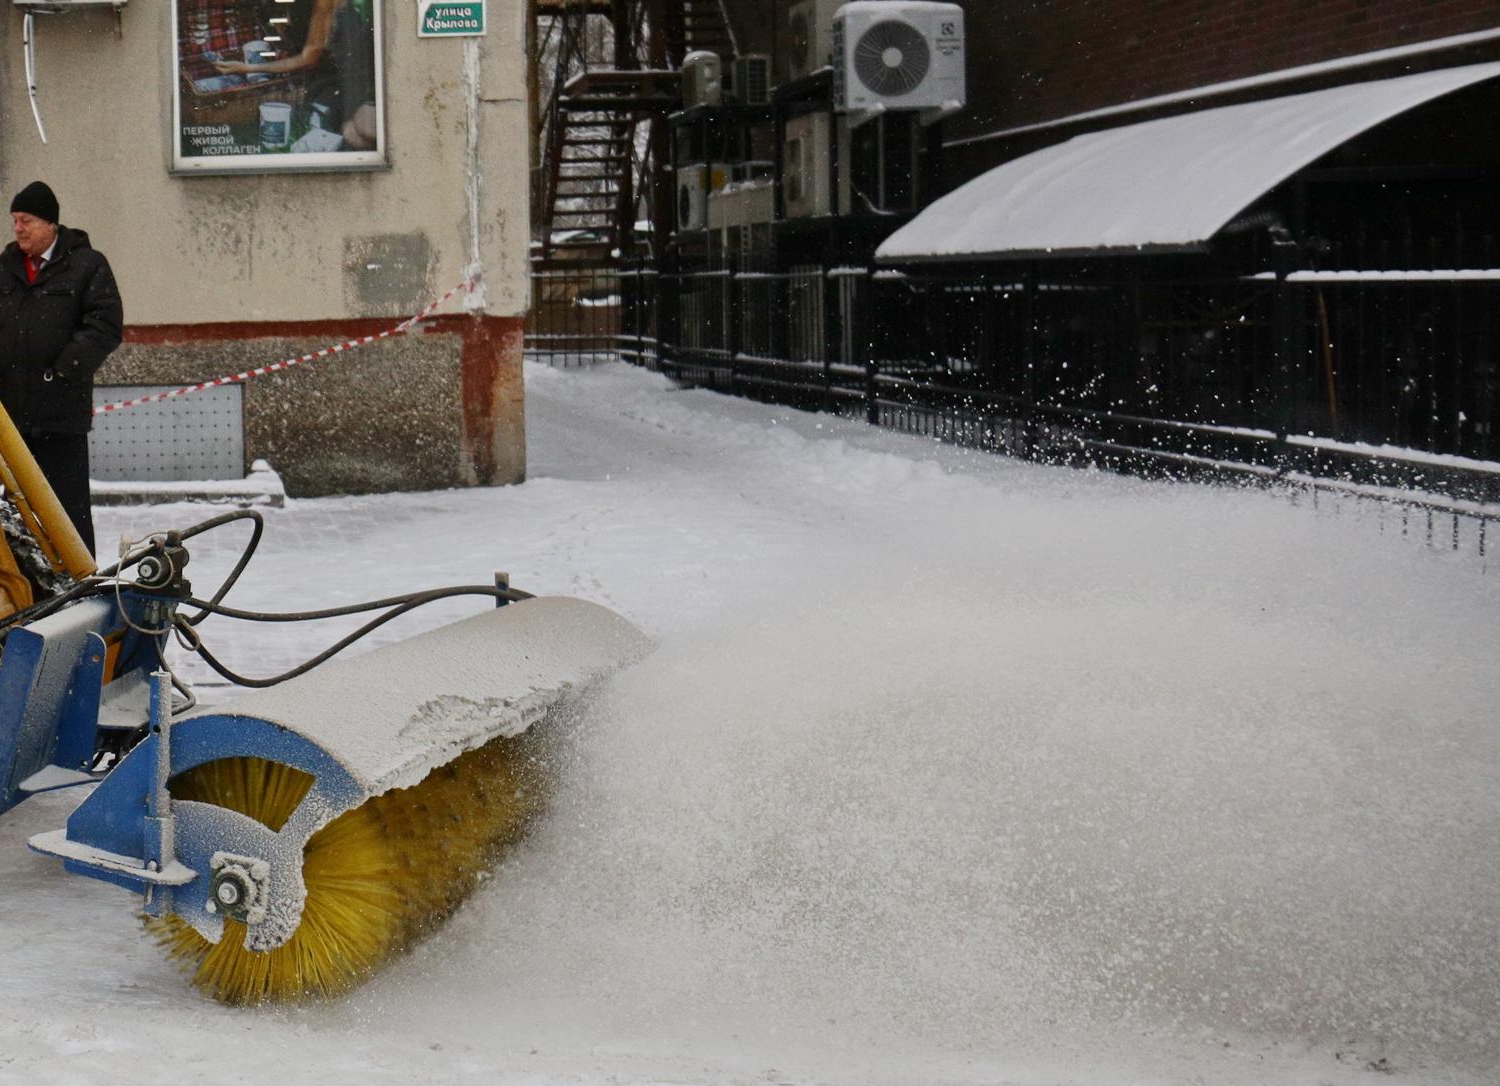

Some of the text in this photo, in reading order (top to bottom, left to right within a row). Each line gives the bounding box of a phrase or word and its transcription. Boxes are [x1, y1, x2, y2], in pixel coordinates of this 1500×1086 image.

[435, 7, 472, 19] улица
[426, 17, 478, 31] Крылова
[183, 125, 230, 135] ПЕРВЫЙ
[192, 135, 234, 146] ЖИВОЙ
[202, 145, 261, 155] КОЛЛАГЕН
